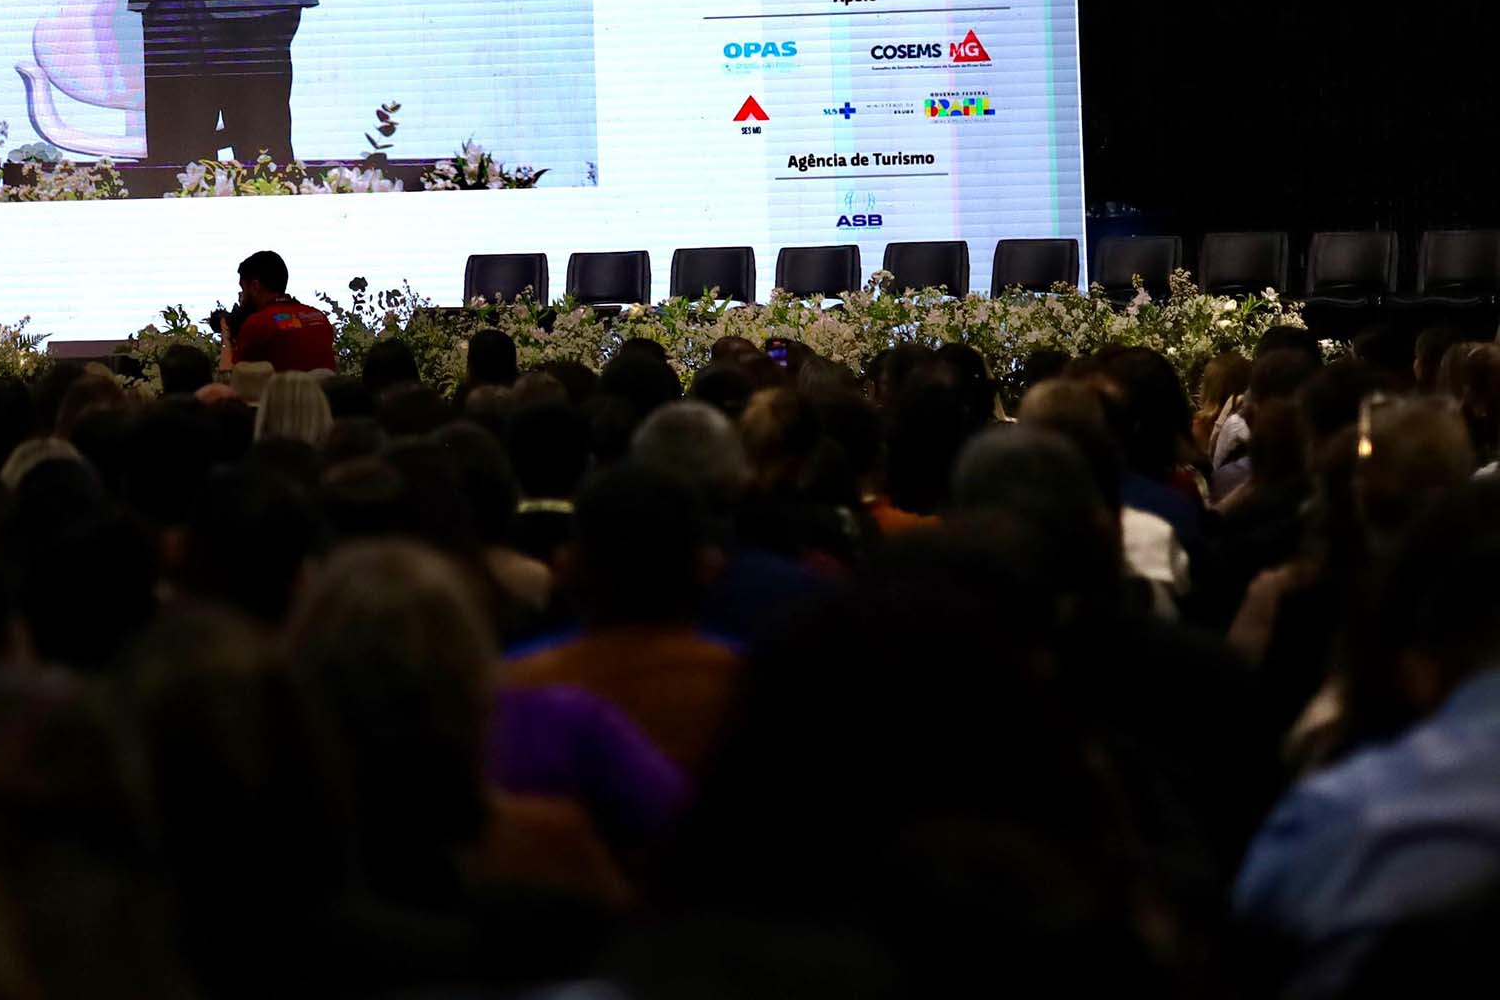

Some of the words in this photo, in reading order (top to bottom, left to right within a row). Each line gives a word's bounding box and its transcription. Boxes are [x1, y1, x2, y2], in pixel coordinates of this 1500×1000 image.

[723, 41, 797, 59] OPAS
[871, 43, 942, 60] COSEMS
[949, 42, 980, 57] MG
[924, 98, 995, 117] BRASIL
[787, 154, 847, 172] Agência
[850, 153, 869, 166] de
[873, 152, 935, 166] Turismo
[836, 214, 883, 227] ASB
